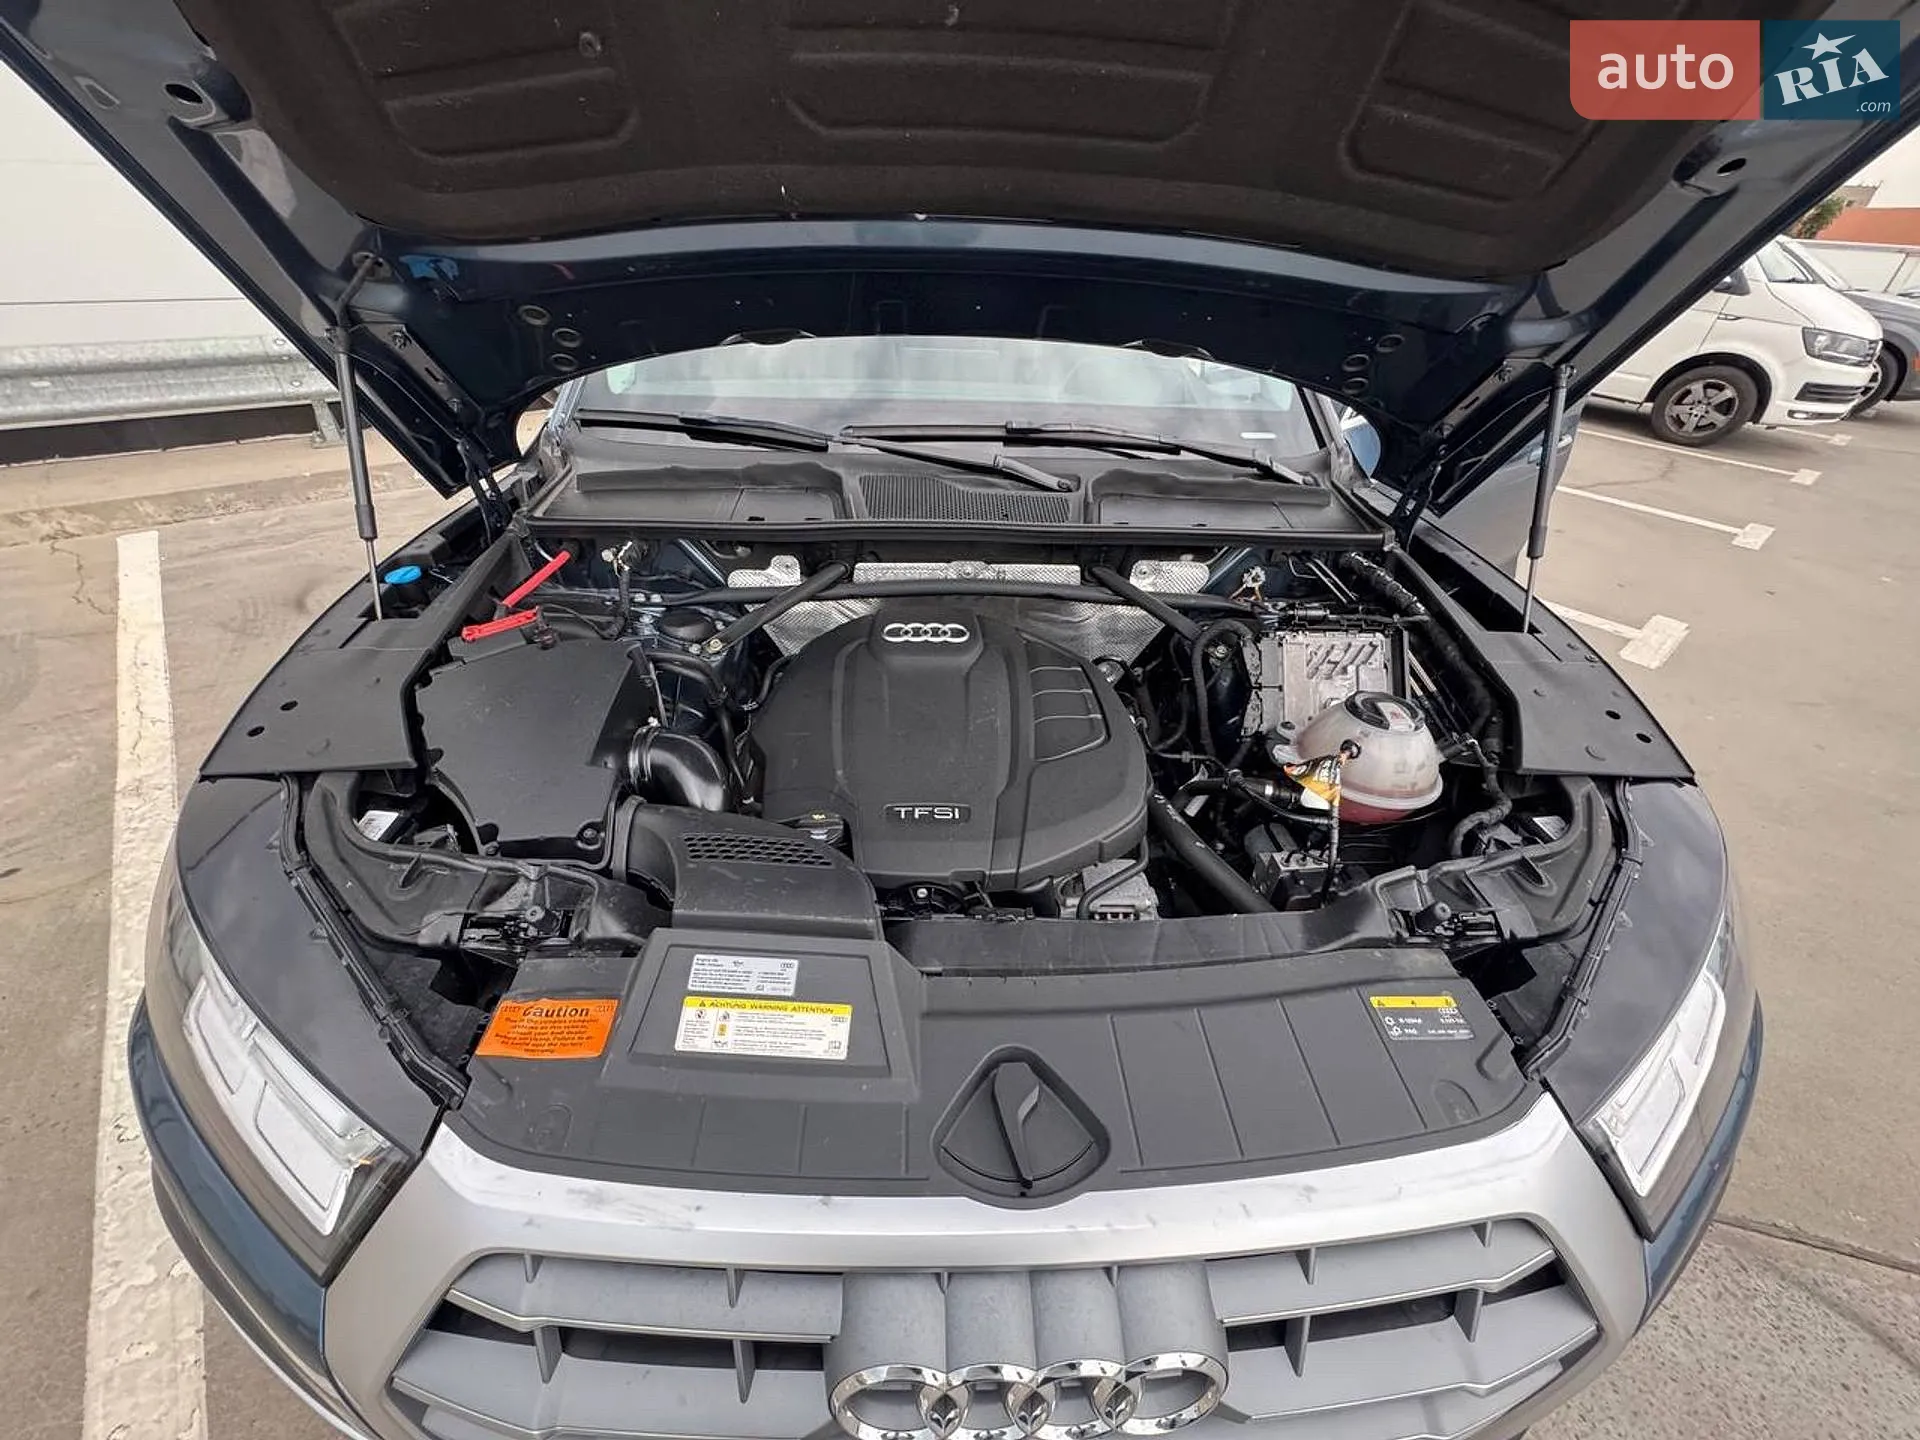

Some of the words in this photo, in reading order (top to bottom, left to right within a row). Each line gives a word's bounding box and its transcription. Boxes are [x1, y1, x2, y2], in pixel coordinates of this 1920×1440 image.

[895, 807, 959, 819] TFSI
[522, 1006, 589, 1017] Caution
[708, 1000, 747, 1009] ACHTUNG
[750, 1003, 788, 1012] WARNING
[791, 1004, 834, 1014] ATTENTION
